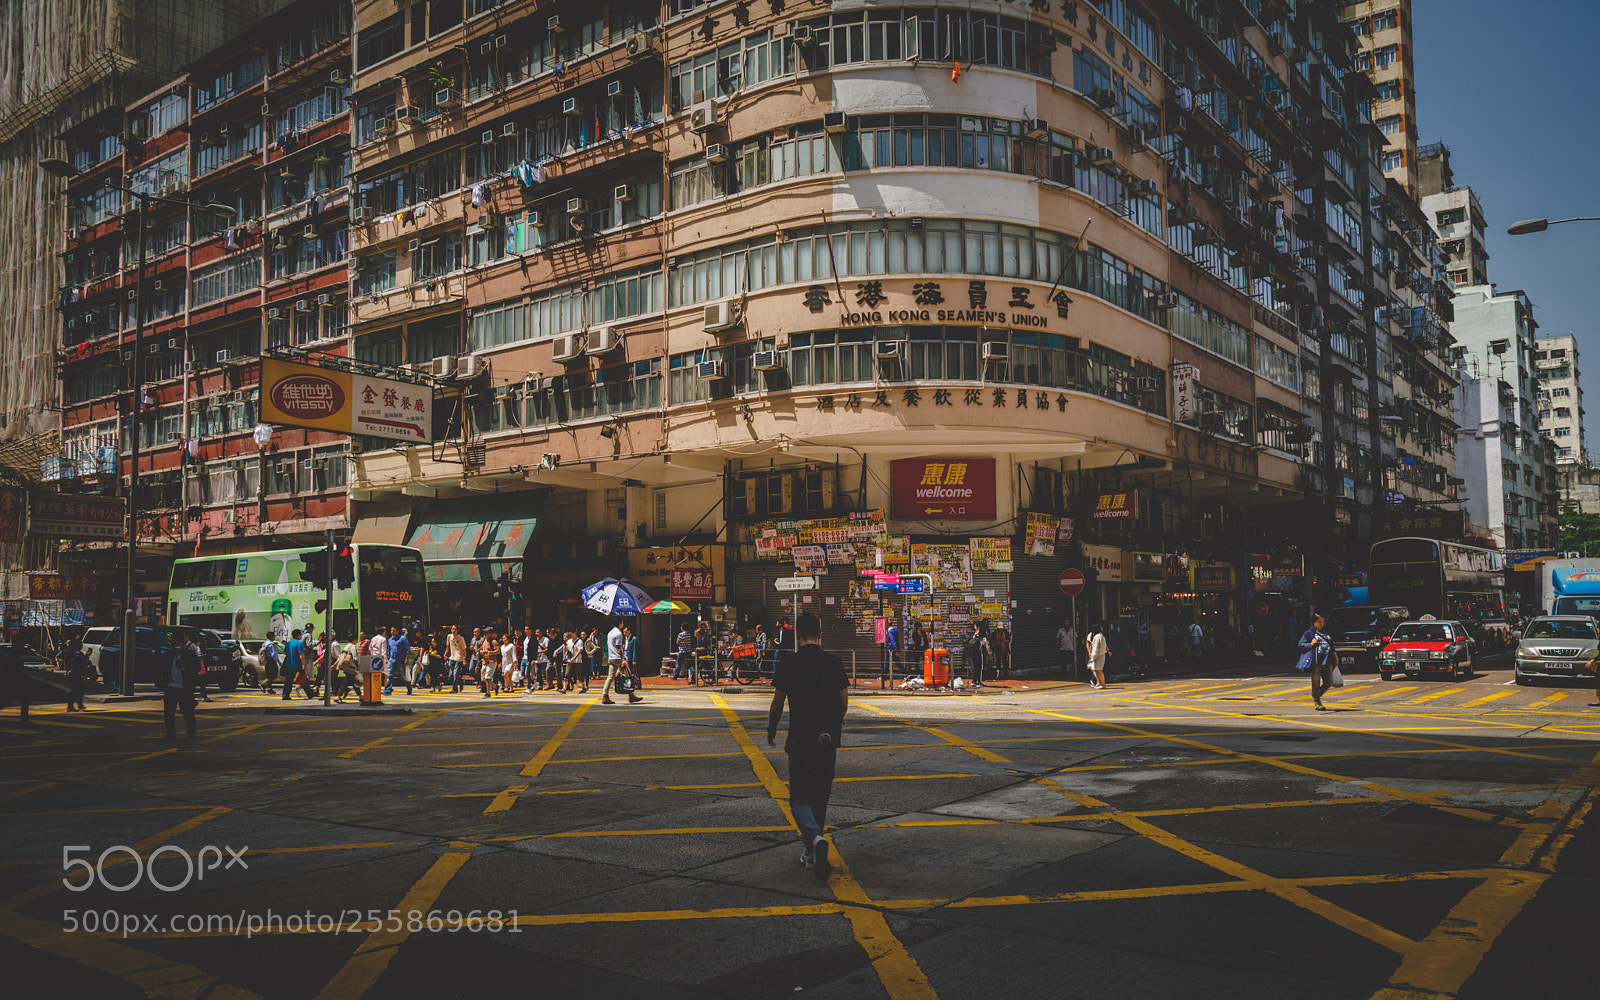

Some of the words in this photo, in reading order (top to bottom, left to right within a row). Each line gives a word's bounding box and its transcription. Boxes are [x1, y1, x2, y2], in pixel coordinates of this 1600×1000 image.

[802, 280, 1073, 320] 香港海員工會
[841, 310, 882, 326] HONG
[889, 310, 930, 322] KONG
[938, 310, 1006, 324] SEAMEN'S
[1012, 313, 1048, 328] UNION
[282, 383, 333, 400] 維他奶
[816, 387, 1069, 413] 酒店及餐飲從業員協會
[283, 400, 333, 412] vitasoy
[920, 463, 968, 485] 惠康
[916, 486, 973, 498] wellcome
[1096, 493, 1127, 510] 惠康
[949, 506, 966, 515] 入口
[1093, 509, 1130, 519] wellcome
